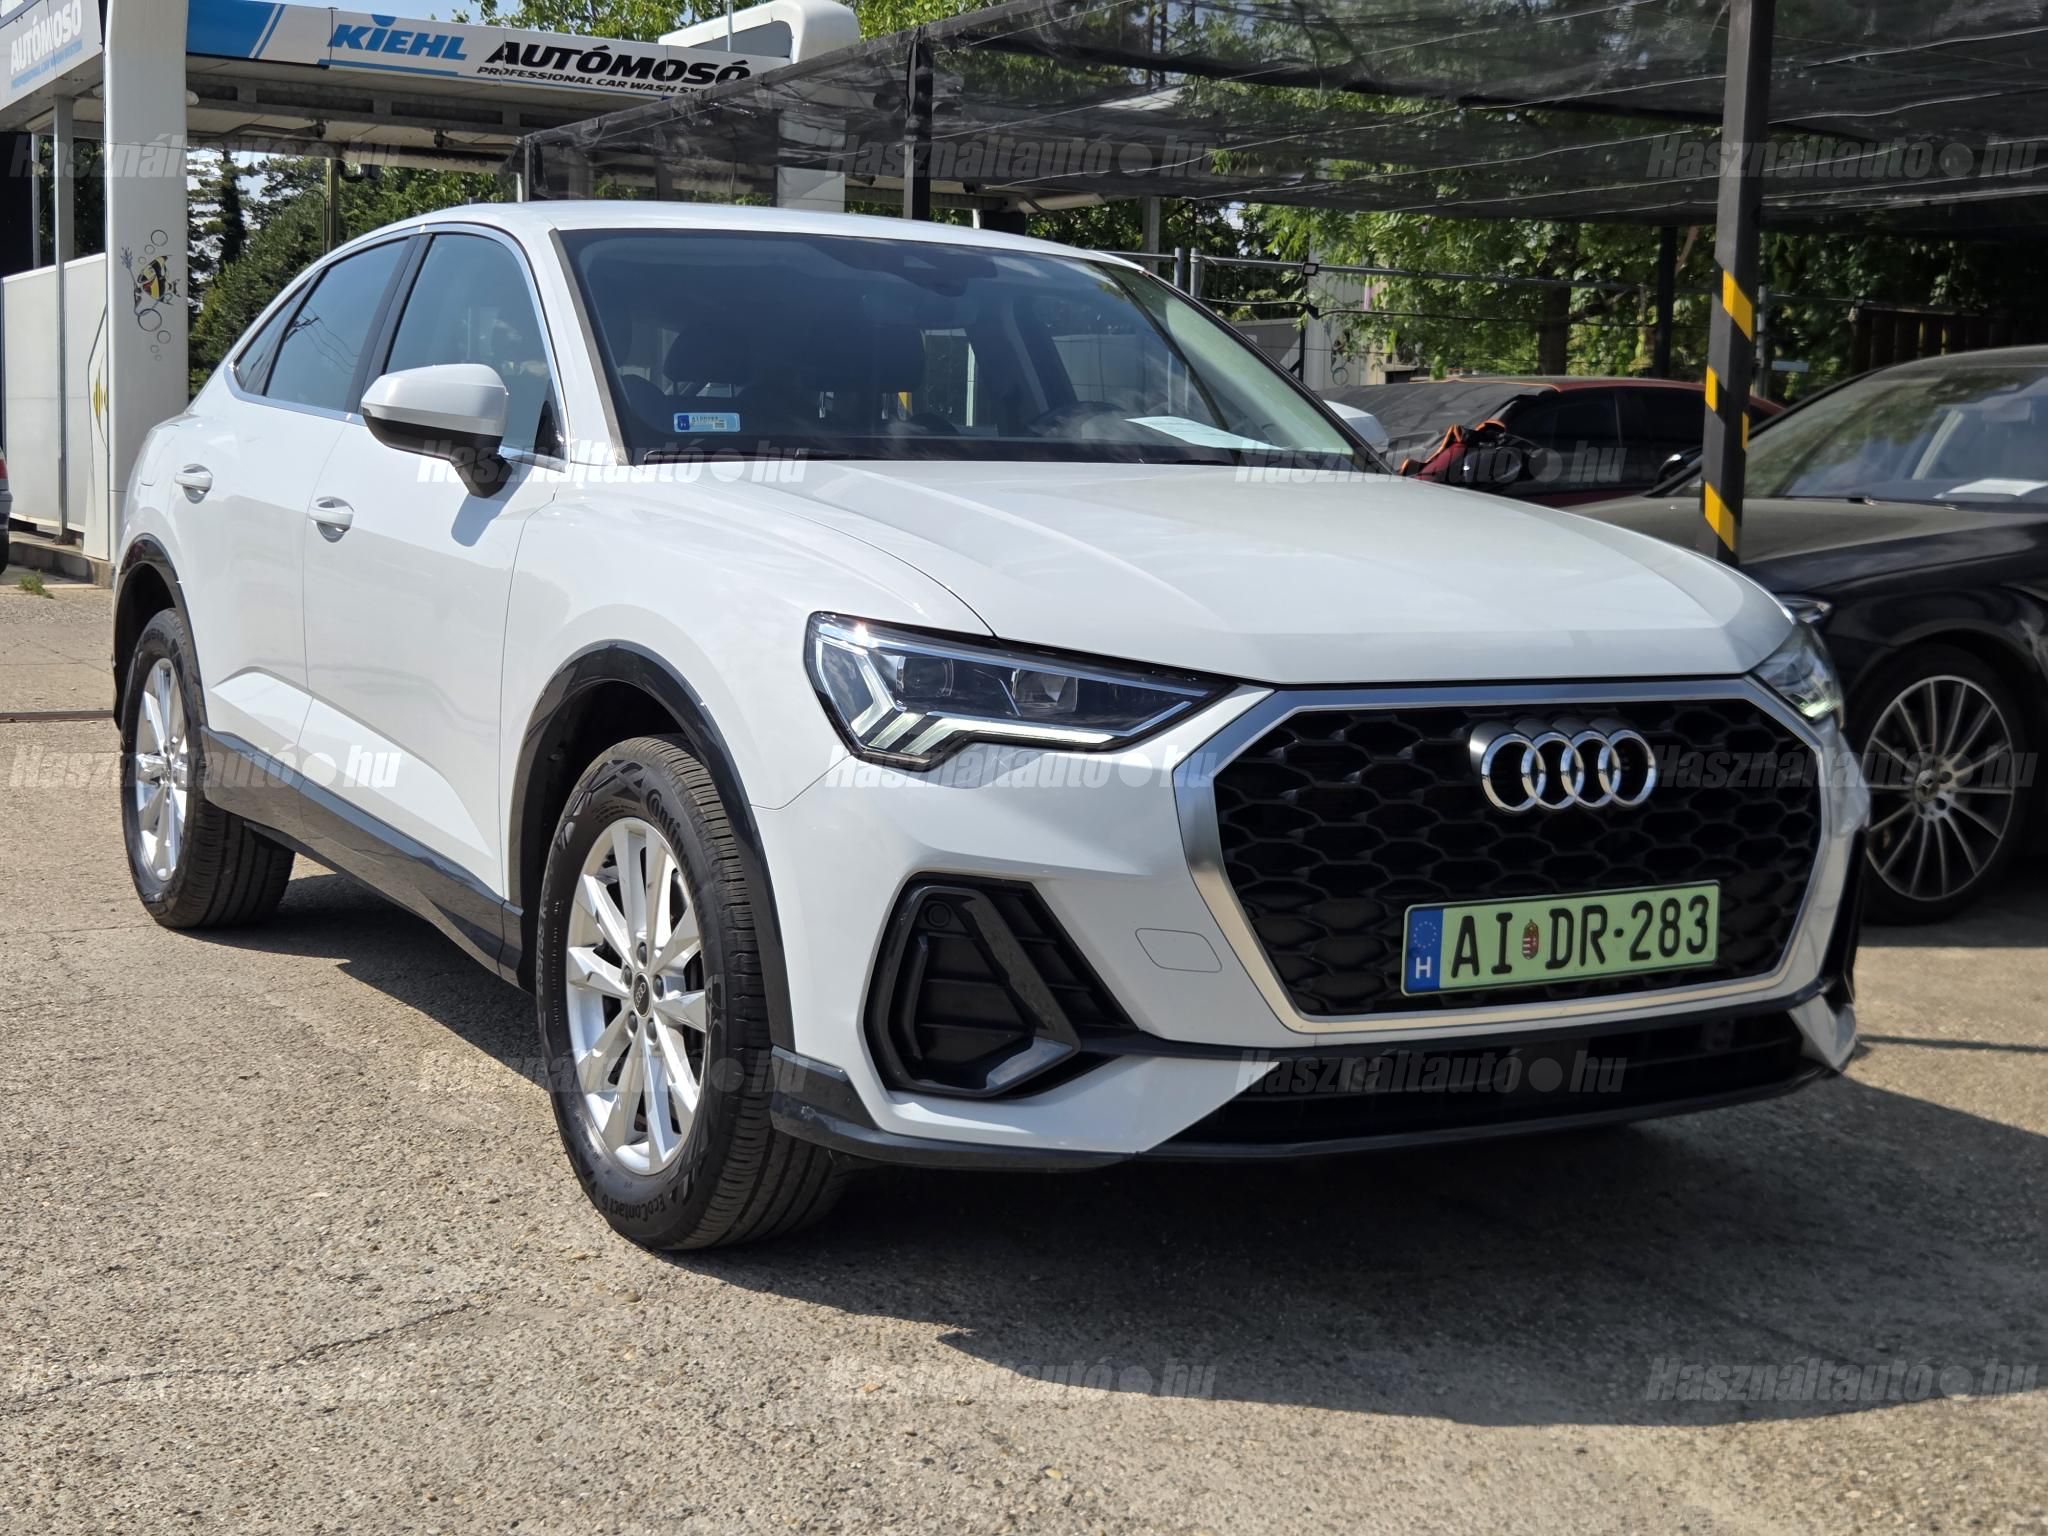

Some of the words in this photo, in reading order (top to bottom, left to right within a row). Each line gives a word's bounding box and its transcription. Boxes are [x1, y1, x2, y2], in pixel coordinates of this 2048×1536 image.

[327, 14, 468, 61] KIEHL
[476, 66, 593, 85] PROFESSIONAL
[596, 78, 628, 89] CAR
[630, 82, 678, 93] WASH
[484, 41, 751, 86] AUTÓMOSÓ
[1415, 956, 1432, 980] H
